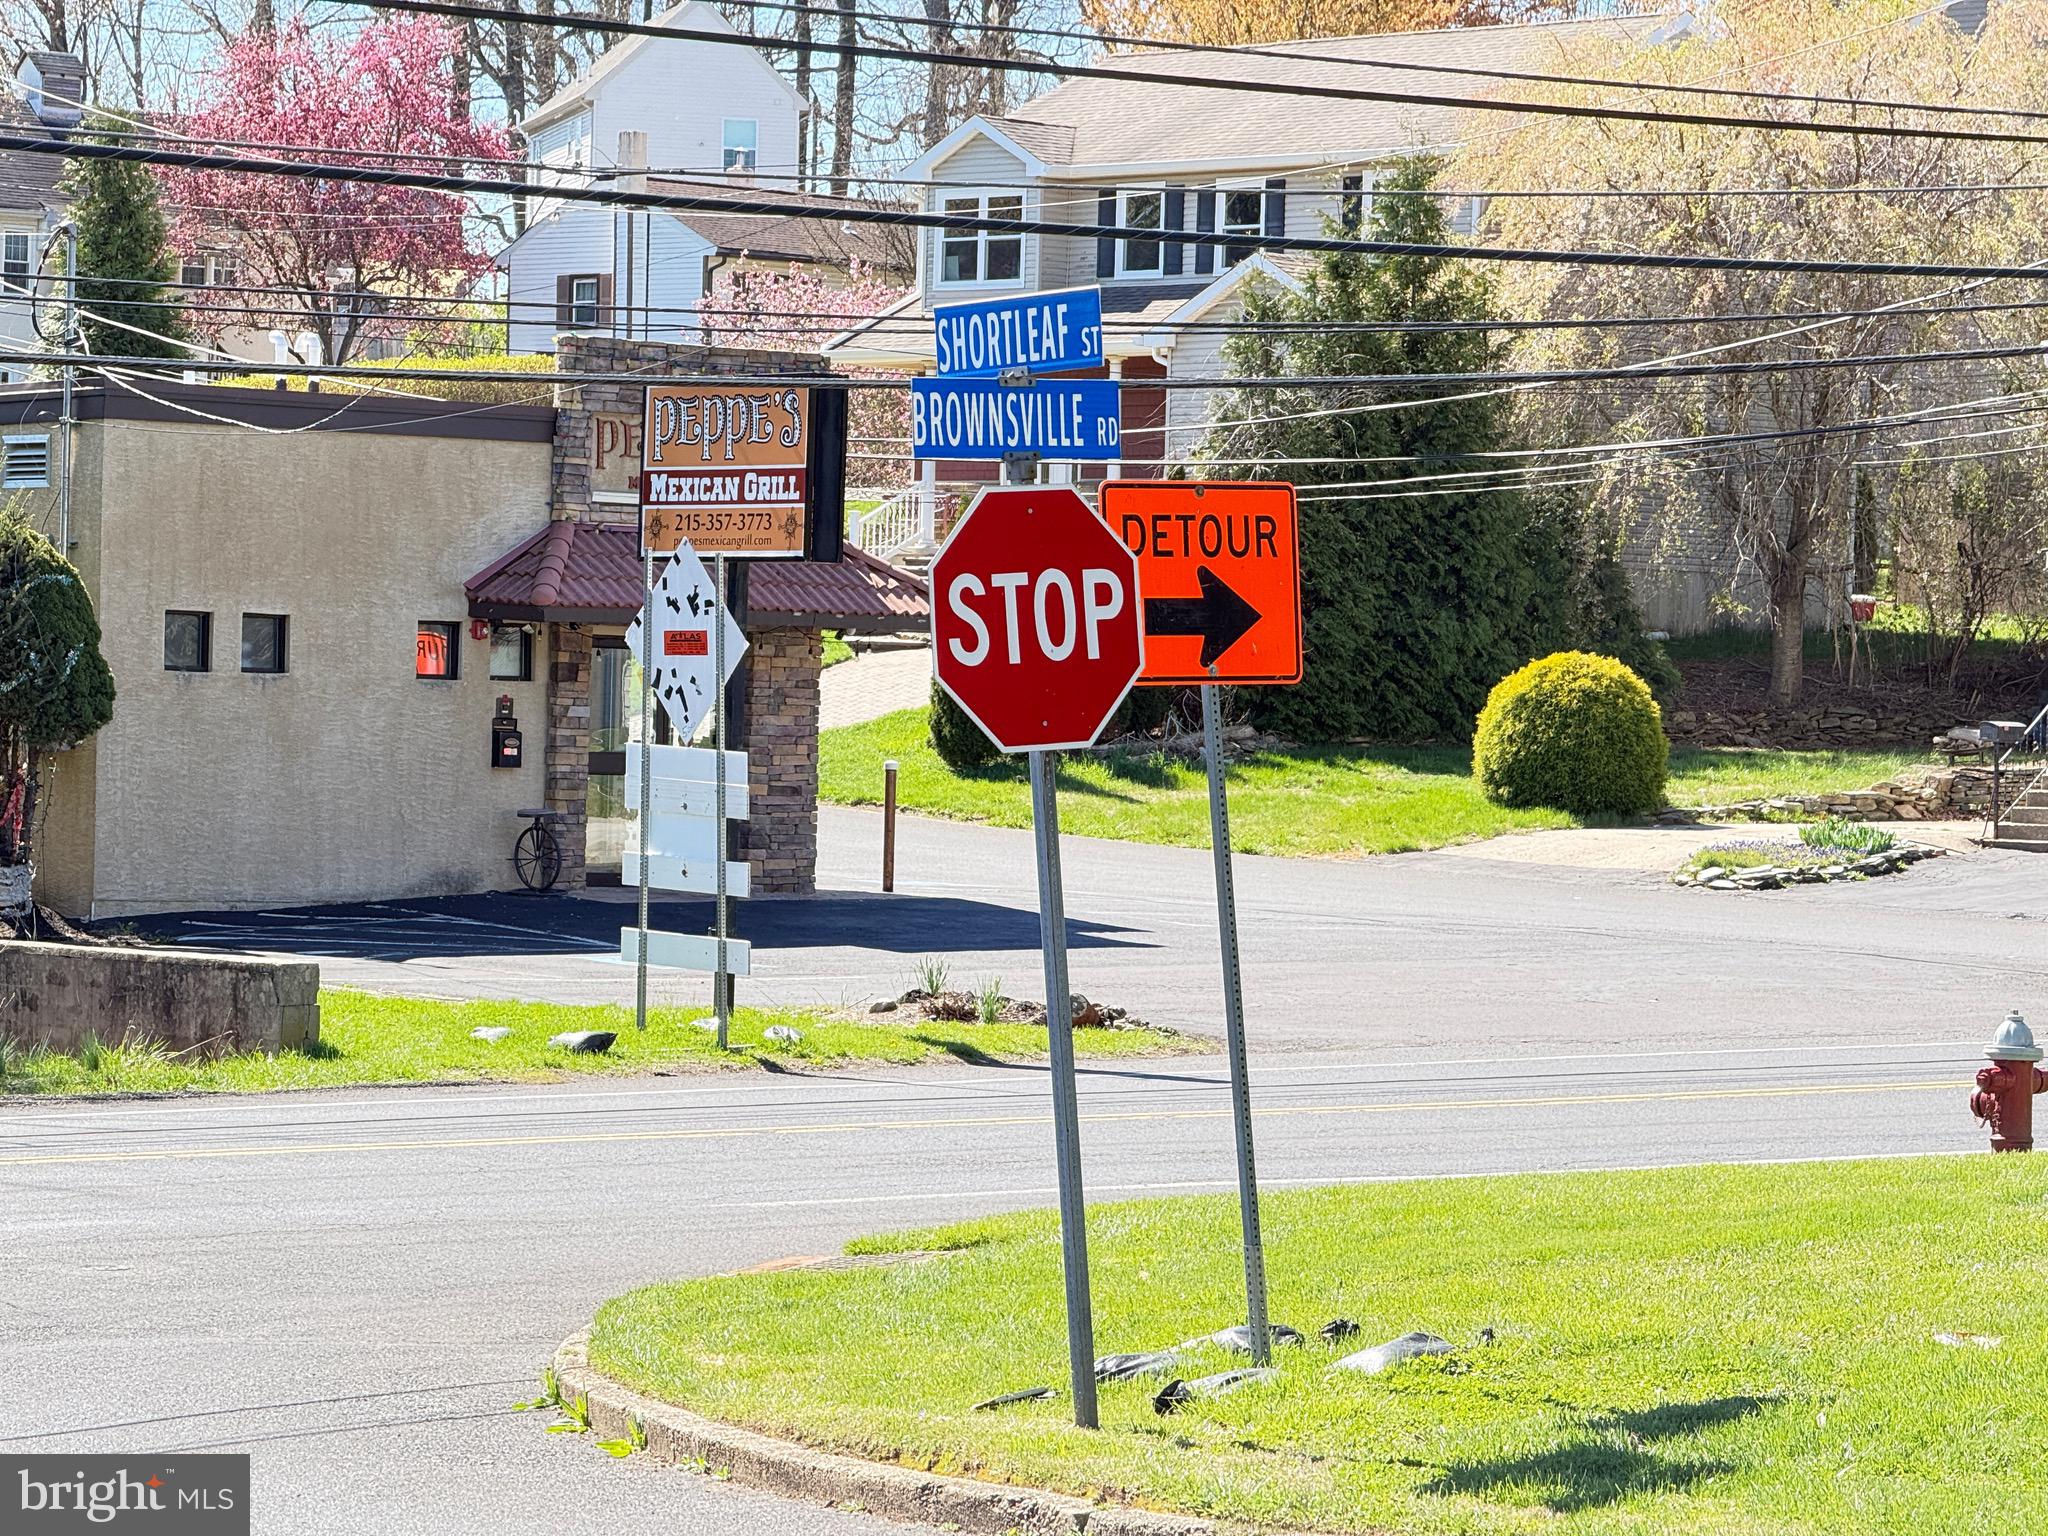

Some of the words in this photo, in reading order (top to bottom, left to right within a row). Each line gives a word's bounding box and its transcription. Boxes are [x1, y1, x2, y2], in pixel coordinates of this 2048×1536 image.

[938, 304, 1068, 373] SHORTLEAF
[1081, 326, 1100, 357] ST
[653, 389, 802, 461] PEPPE'S
[913, 392, 1085, 447] BROWNSVILLE
[1097, 416, 1118, 446] RD
[673, 534, 772, 550] ppesmexicangrill.com
[674, 512, 773, 532] 215-357-3773
[1121, 514, 1278, 558] DETOUR
[948, 567, 1124, 667] STOP
